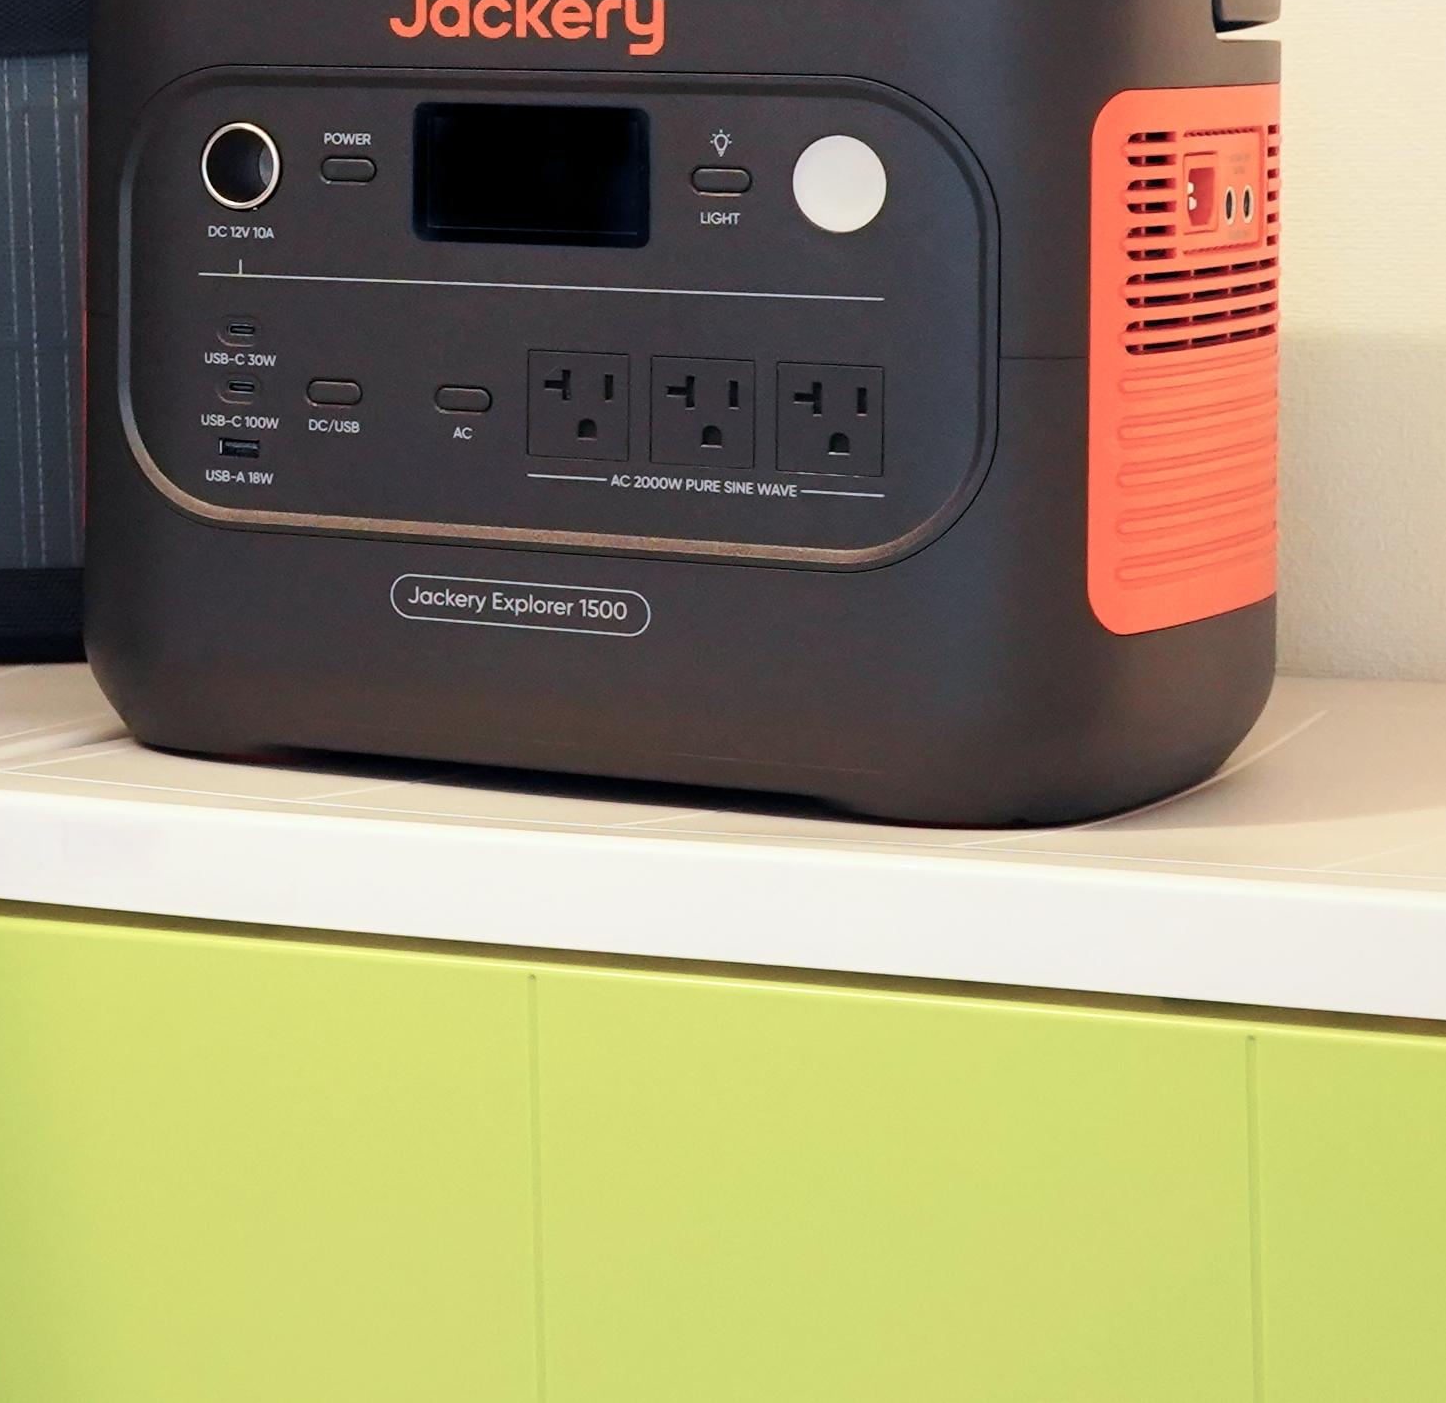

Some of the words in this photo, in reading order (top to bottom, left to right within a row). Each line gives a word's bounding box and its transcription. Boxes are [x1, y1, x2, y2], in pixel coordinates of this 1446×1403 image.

[323, 132, 372, 146] POWER
[700, 211, 741, 225] LIGHT
[207, 225, 228, 238] DC
[230, 225, 251, 239] 12V
[252, 226, 275, 240] 10A
[204, 352, 245, 366] USB-C
[247, 354, 277, 367] 30W
[200, 413, 242, 428] USB-C
[244, 416, 280, 430] 100W
[308, 419, 361, 434] DC/USB
[452, 426, 473, 440] AC
[205, 469, 246, 484] USB-A
[248, 471, 274, 485] 18W
[610, 474, 631, 488] AC
[633, 475, 683, 491] 2000W
[685, 478, 721, 493] PURE
[723, 480, 754, 495] SINE
[756, 482, 798, 498] WAVE
[407, 586, 487, 614] Jackery
[491, 592, 574, 619] Explorer
[578, 598, 628, 622] 1500
